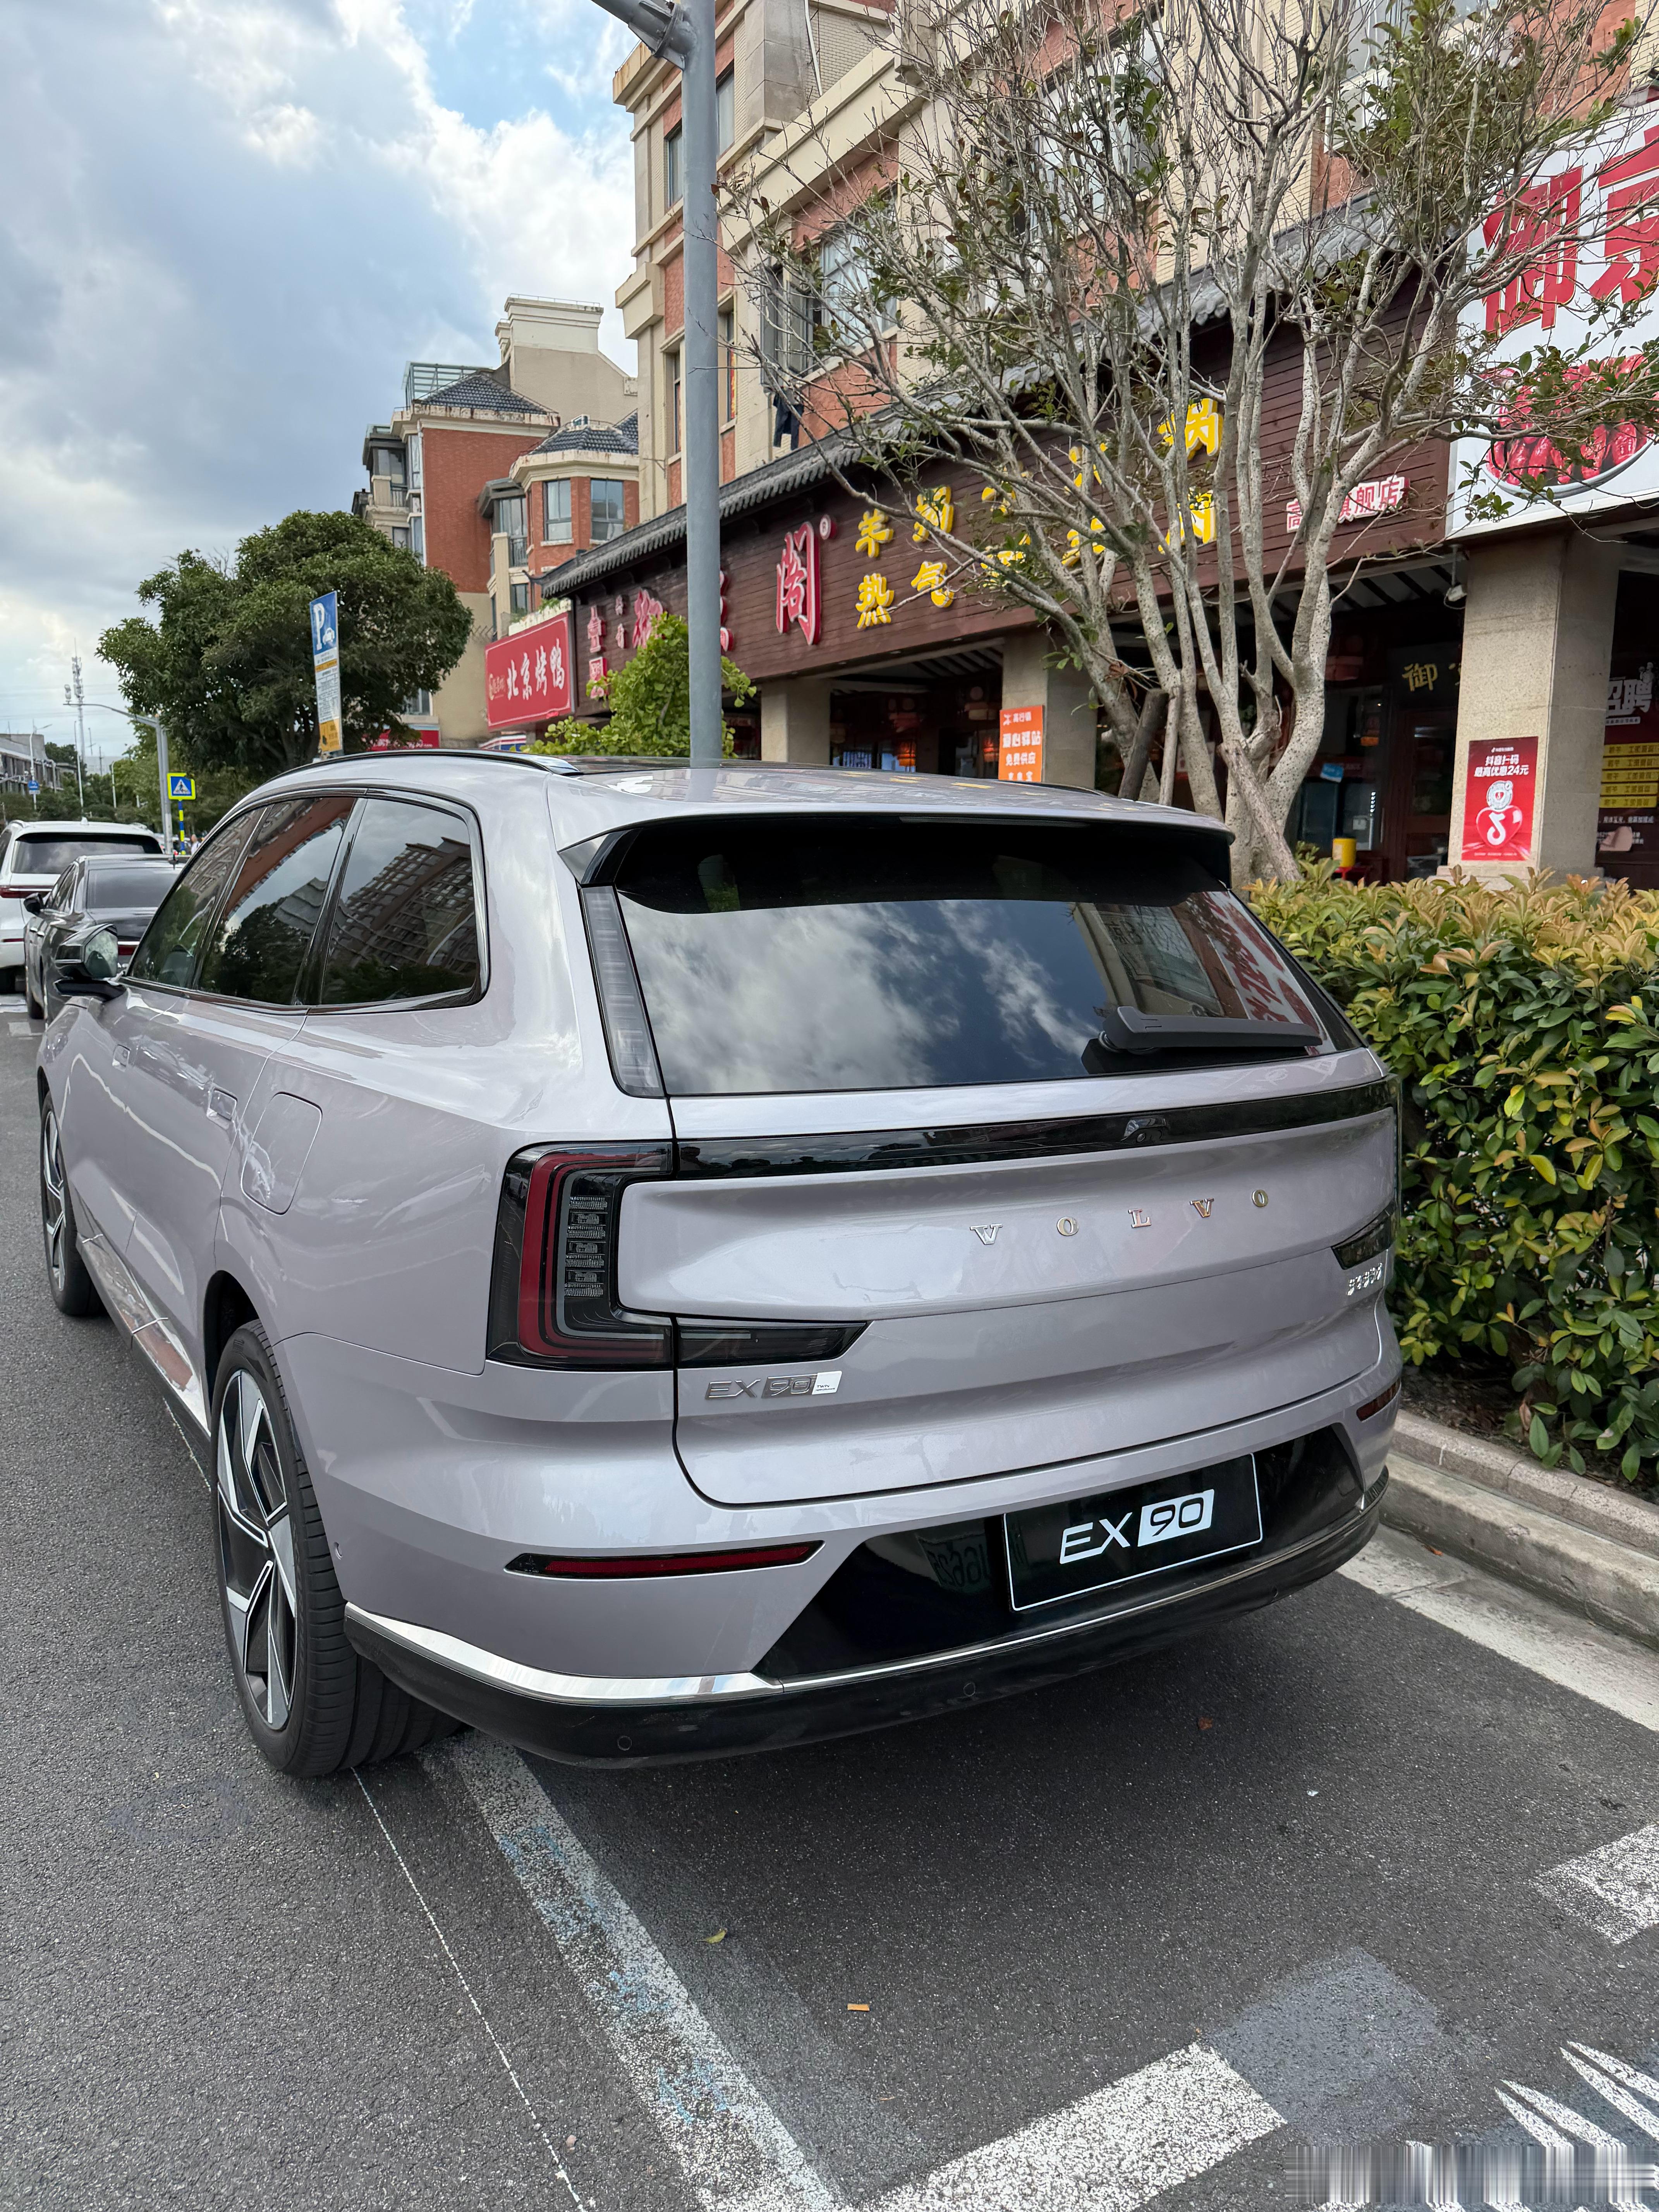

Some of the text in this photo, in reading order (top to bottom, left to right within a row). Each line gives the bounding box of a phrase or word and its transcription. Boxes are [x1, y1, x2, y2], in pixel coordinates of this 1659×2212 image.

[313, 603, 325, 651] P
[507, 638, 565, 700] 北京烤鸭
[970, 1188, 1269, 1245] VOLVO
[704, 1374, 816, 1400] EX90
[1059, 1489, 1214, 1564] EX90
